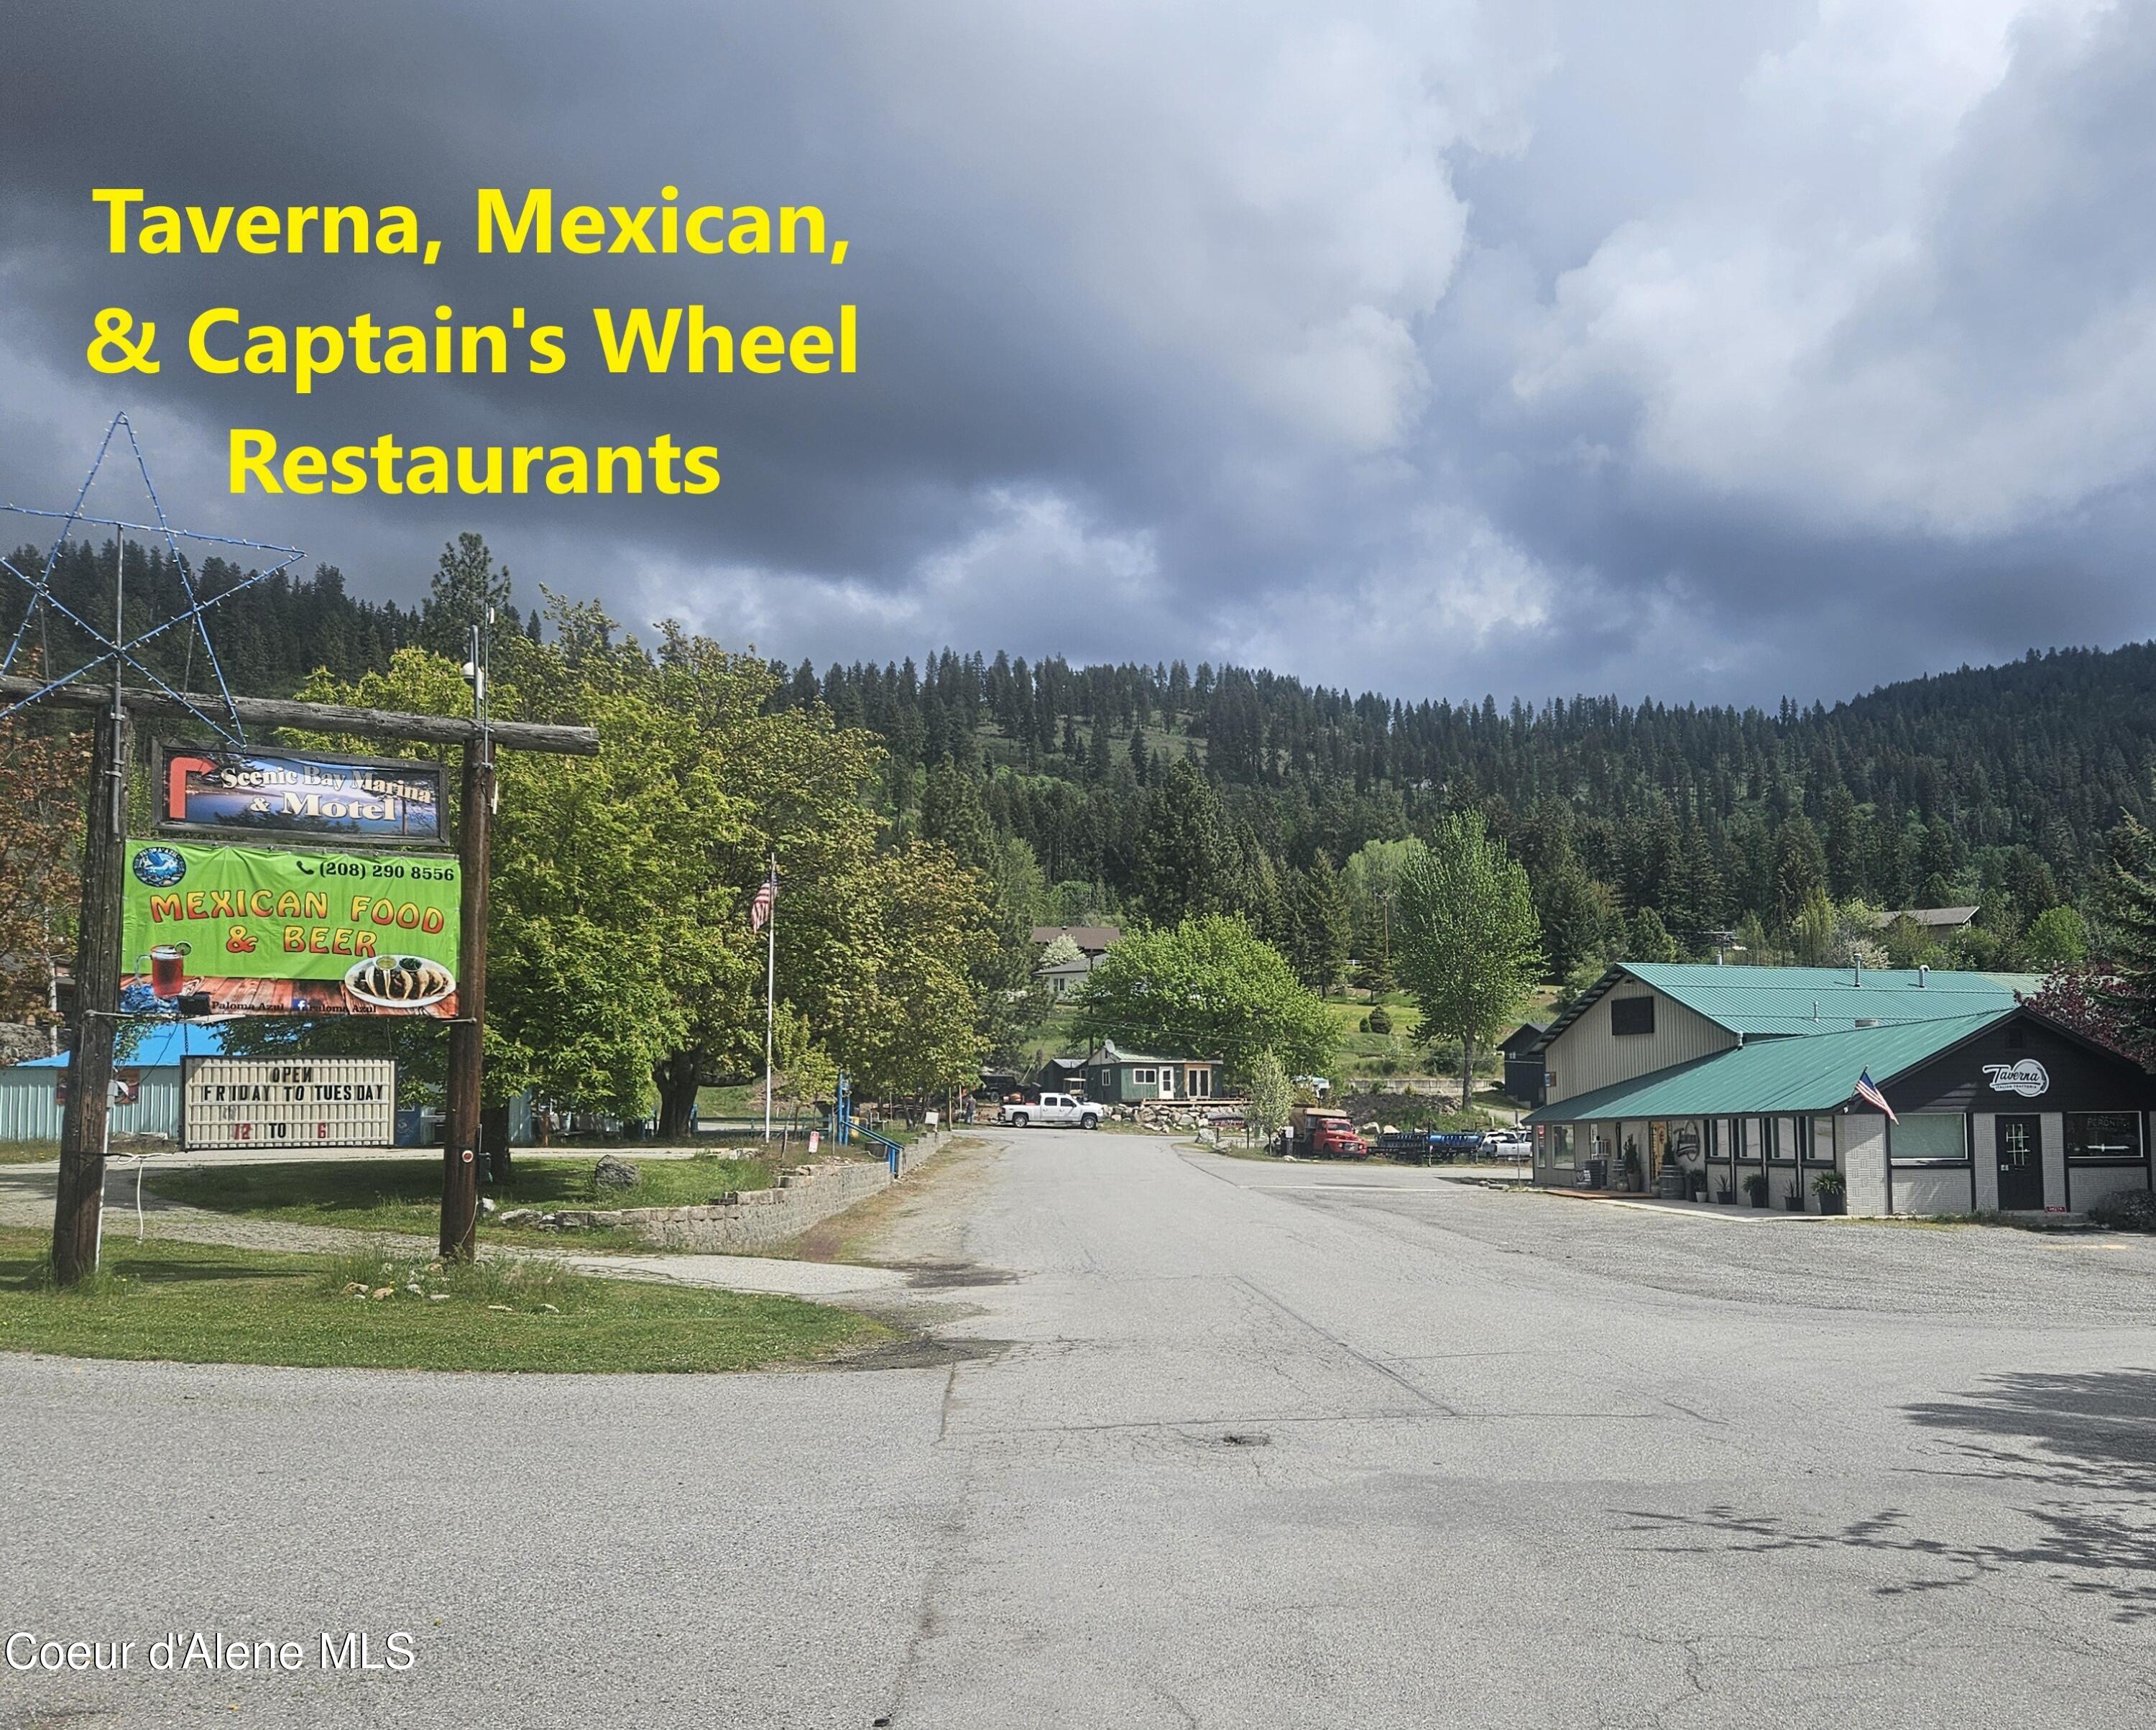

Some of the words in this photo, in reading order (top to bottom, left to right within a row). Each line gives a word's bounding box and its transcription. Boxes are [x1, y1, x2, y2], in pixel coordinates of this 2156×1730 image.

[221, 765, 297, 789] Scenic
[302, 765, 346, 791] Bay
[350, 769, 433, 804] Marina
[249, 796, 271, 813] &
[282, 790, 396, 822] Motel
[320, 861, 367, 879] (208)
[372, 864, 405, 879] 290
[410, 868, 455, 882] 8556
[150, 889, 328, 924] MEXICAN
[351, 896, 445, 934] FOOD
[226, 925, 259, 954] &
[282, 925, 377, 958] BEER
[211, 1001, 257, 1011] Paloma
[258, 1001, 285, 1011] Azul
[272, 1067, 312, 1083] OPEN
[1984, 1067, 2040, 1084] Taverna
[204, 1085, 270, 1101] FRIDAY
[284, 1085, 305, 1101] TO
[315, 1085, 383, 1101] TUESDAY
[234, 1123, 251, 1140] 12
[269, 1123, 286, 1138] TO
[318, 1122, 328, 1138] 6
